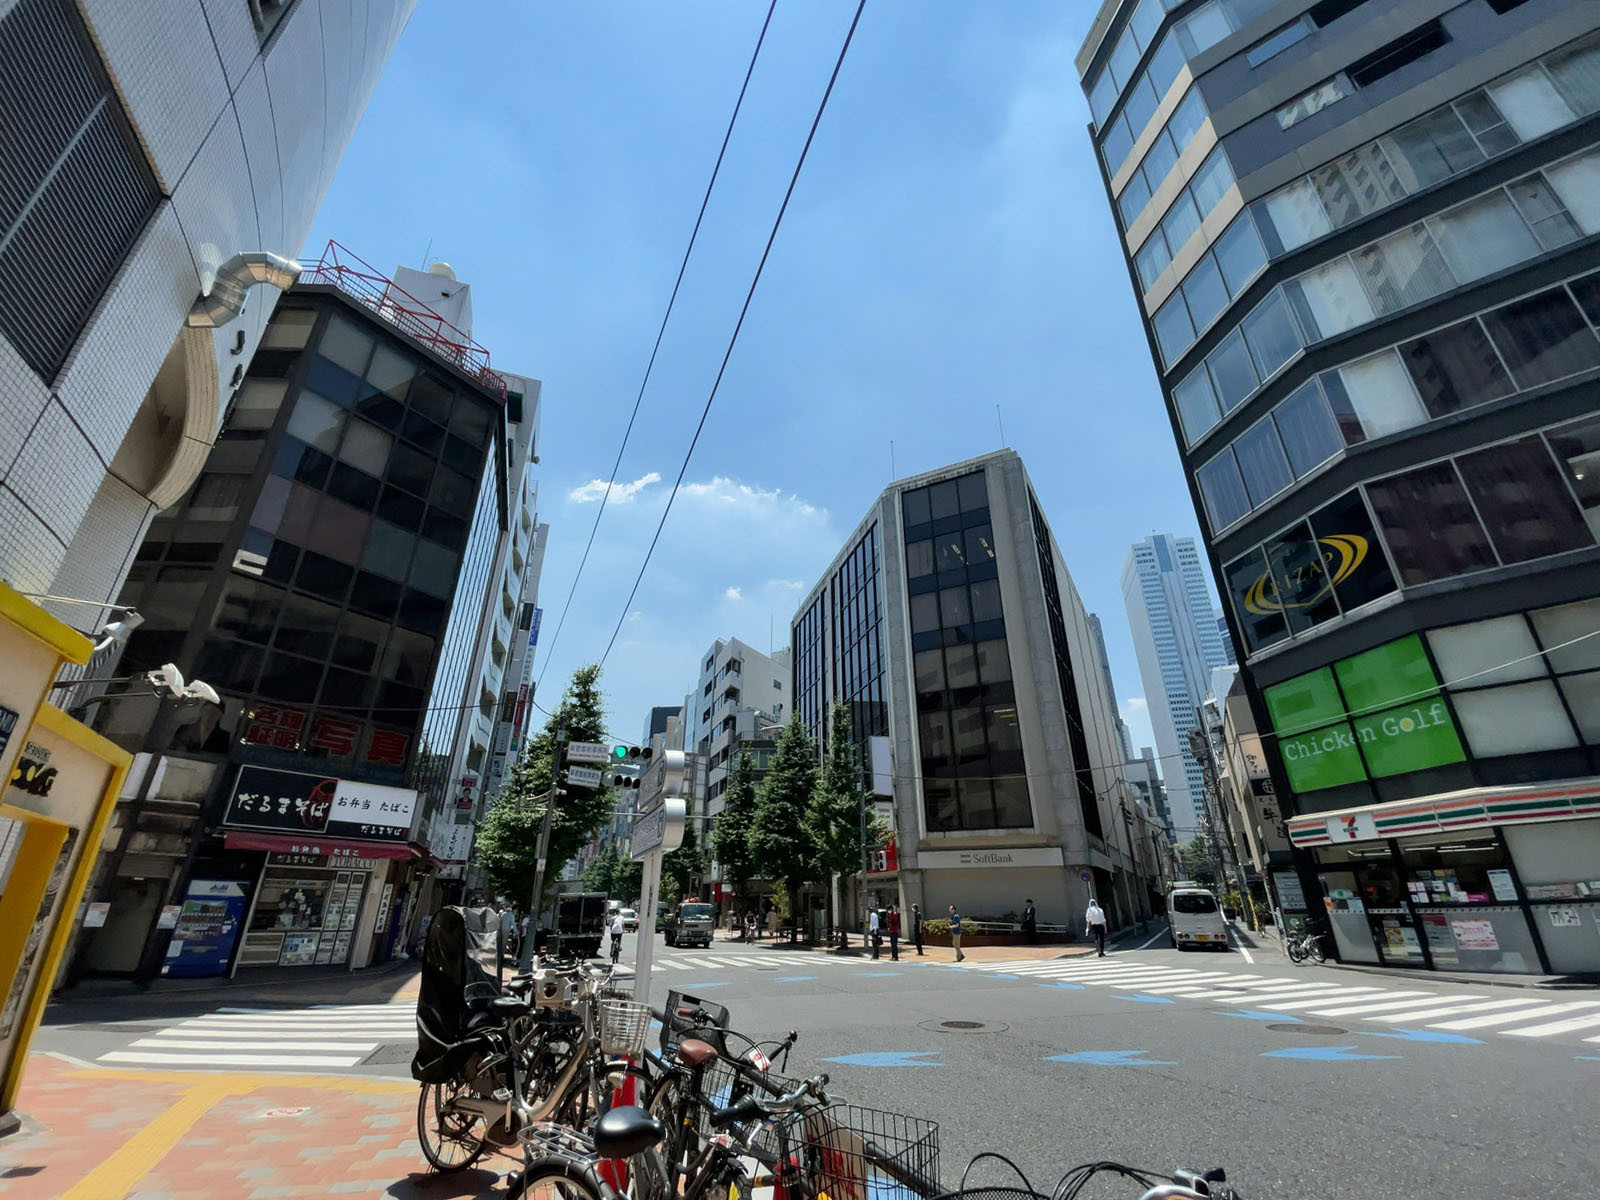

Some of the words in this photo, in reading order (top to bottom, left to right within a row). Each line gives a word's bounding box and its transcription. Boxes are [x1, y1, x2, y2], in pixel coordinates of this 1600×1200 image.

[312, 718, 409, 764] 写真
[1285, 727, 1377, 761] Chicken
[1382, 703, 1446, 737] Golf
[238, 792, 330, 818] だるまそば
[337, 796, 372, 811] お弁当
[379, 800, 410, 815] たばこ
[360, 824, 403, 837] だるまそば
[333, 847, 361, 858] たばこ
[973, 853, 1014, 863] SoftBank
